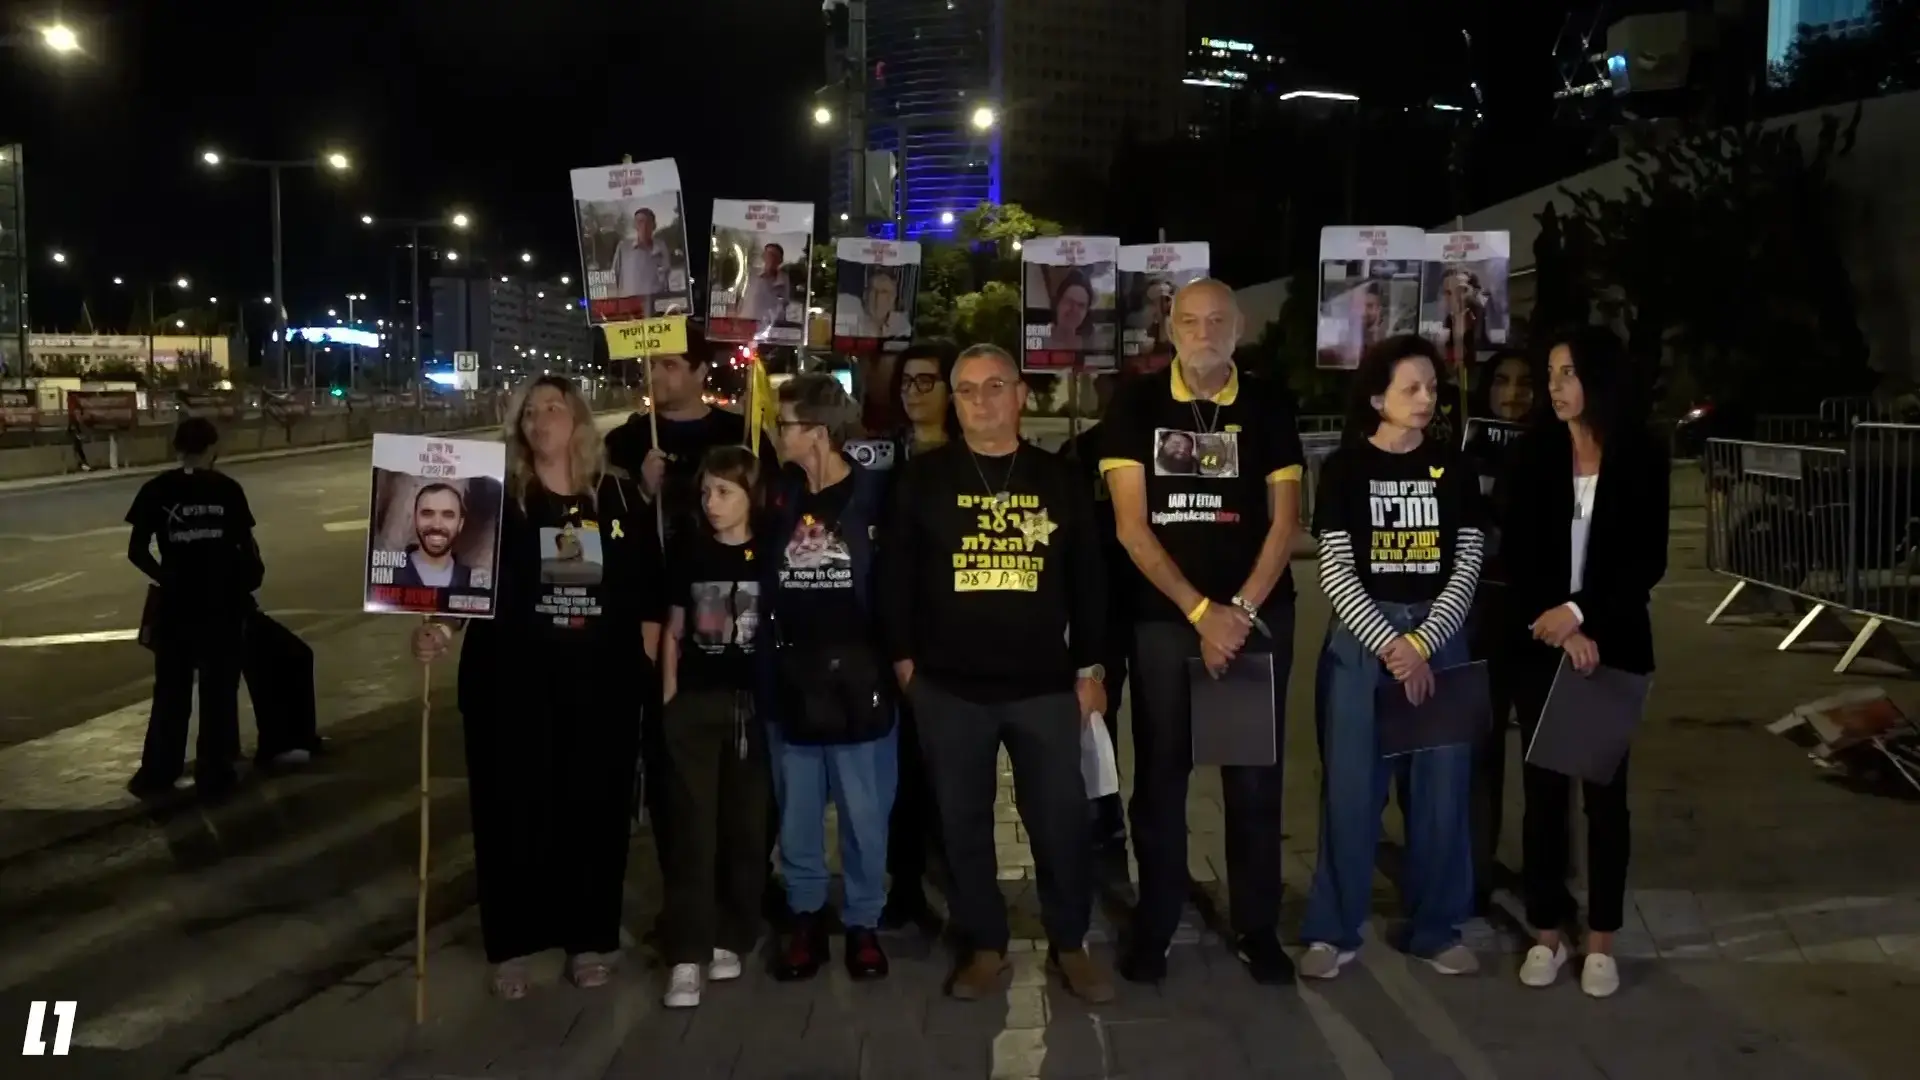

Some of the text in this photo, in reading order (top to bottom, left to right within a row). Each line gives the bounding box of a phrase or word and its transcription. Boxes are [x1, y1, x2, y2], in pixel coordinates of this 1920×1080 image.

[648, 323, 671, 335] אבא
[635, 339, 661, 349] בעה
[1026, 337, 1043, 351] HER
[1370, 497, 1439, 528] מחכים
[977, 513, 1020, 532] רעב
[961, 533, 1024, 551] הצלת
[372, 549, 407, 568] BRING
[952, 553, 1044, 571] החטופים
[371, 567, 394, 584] HIM
[794, 570, 815, 580] now
[816, 567, 825, 580] in
[827, 567, 851, 580] Gaza
